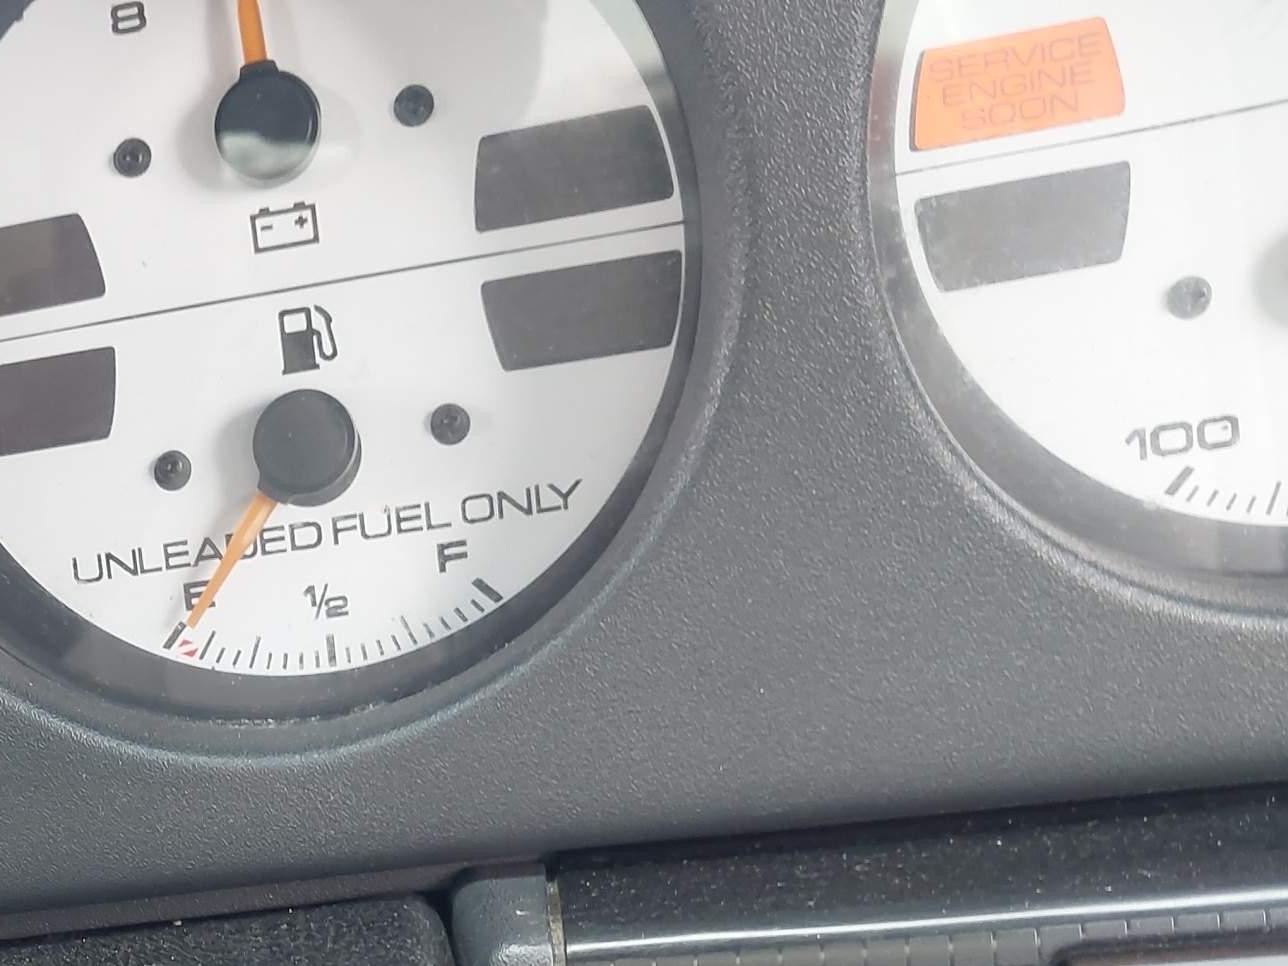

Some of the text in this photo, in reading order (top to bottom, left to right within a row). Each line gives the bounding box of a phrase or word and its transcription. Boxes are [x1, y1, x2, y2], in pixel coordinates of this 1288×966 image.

[110, 0, 147, 34] 8
[928, 31, 1104, 83] SERVICE
[942, 60, 1094, 107] ENGINE
[962, 91, 1080, 131] SOON
[1125, 415, 1240, 461] 100
[332, 501, 452, 546] FUEL
[461, 478, 582, 526] ONLY
[436, 539, 469, 573] F
[183, 579, 216, 611] E
